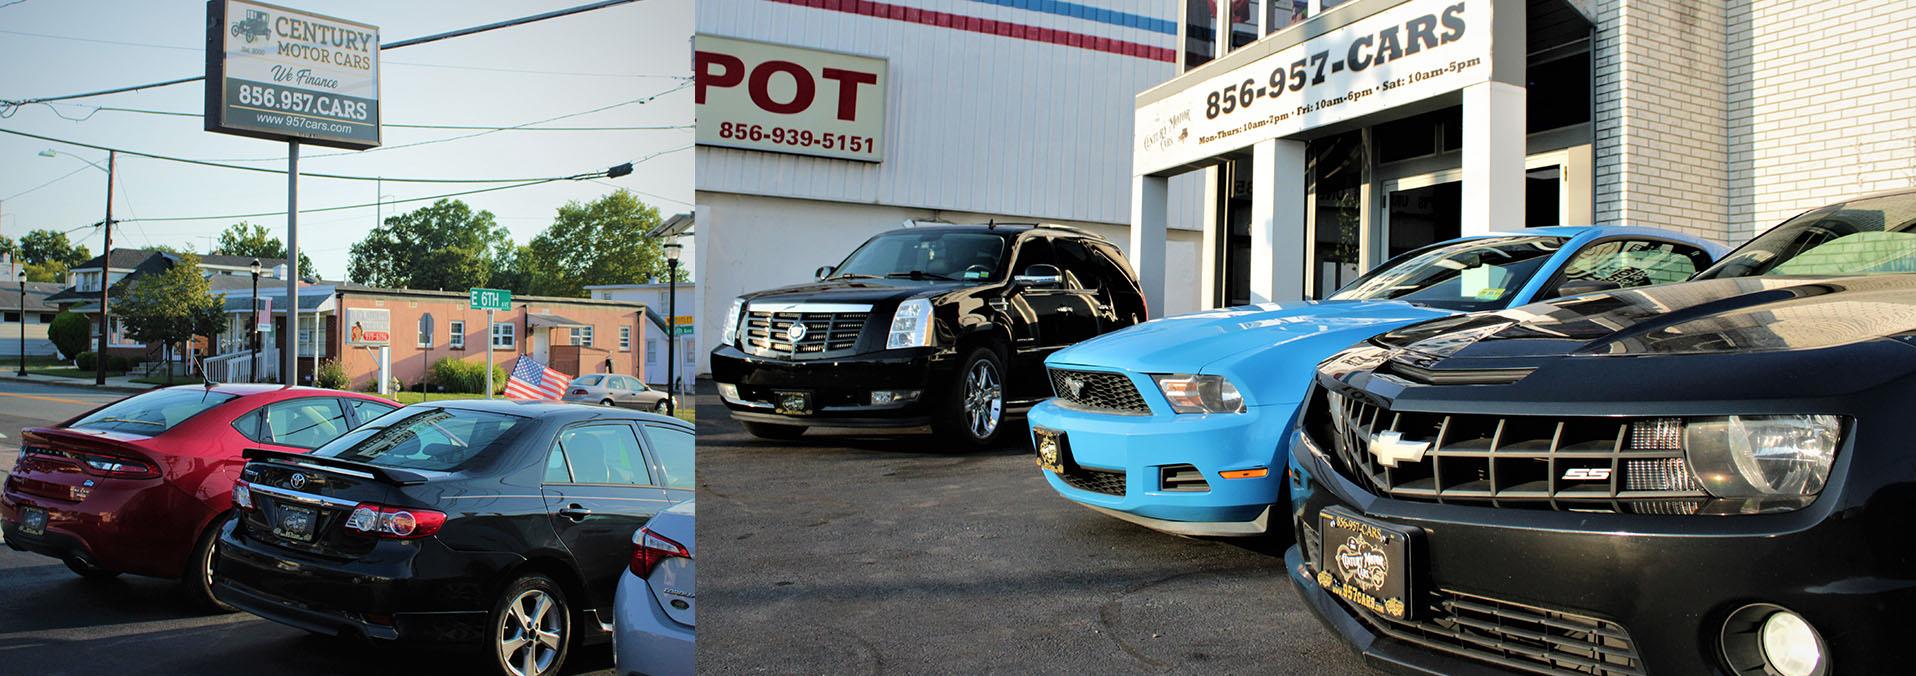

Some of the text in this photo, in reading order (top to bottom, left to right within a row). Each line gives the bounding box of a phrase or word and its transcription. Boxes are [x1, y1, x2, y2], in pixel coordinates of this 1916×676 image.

[275, 16, 372, 53] CENTURY
[277, 41, 370, 70] MOTOR CARS
[1206, 2, 1466, 120] 856-957-CARS
[270, 64, 338, 89] We Finance
[695, 50, 877, 121] POT
[239, 84, 367, 121] 856.957.CARS
[1199, 57, 1481, 144] Mon-Thurs: 10am-7pm Fri: 10am-6pm Sat: 10am-5pm
[719, 121, 873, 153] 856-939-5151
[471, 291, 478, 305] E
[481, 291, 499, 307] 6TH
[1561, 468, 1612, 480] SS
[1336, 516, 1382, 539] 856-957-CARS
